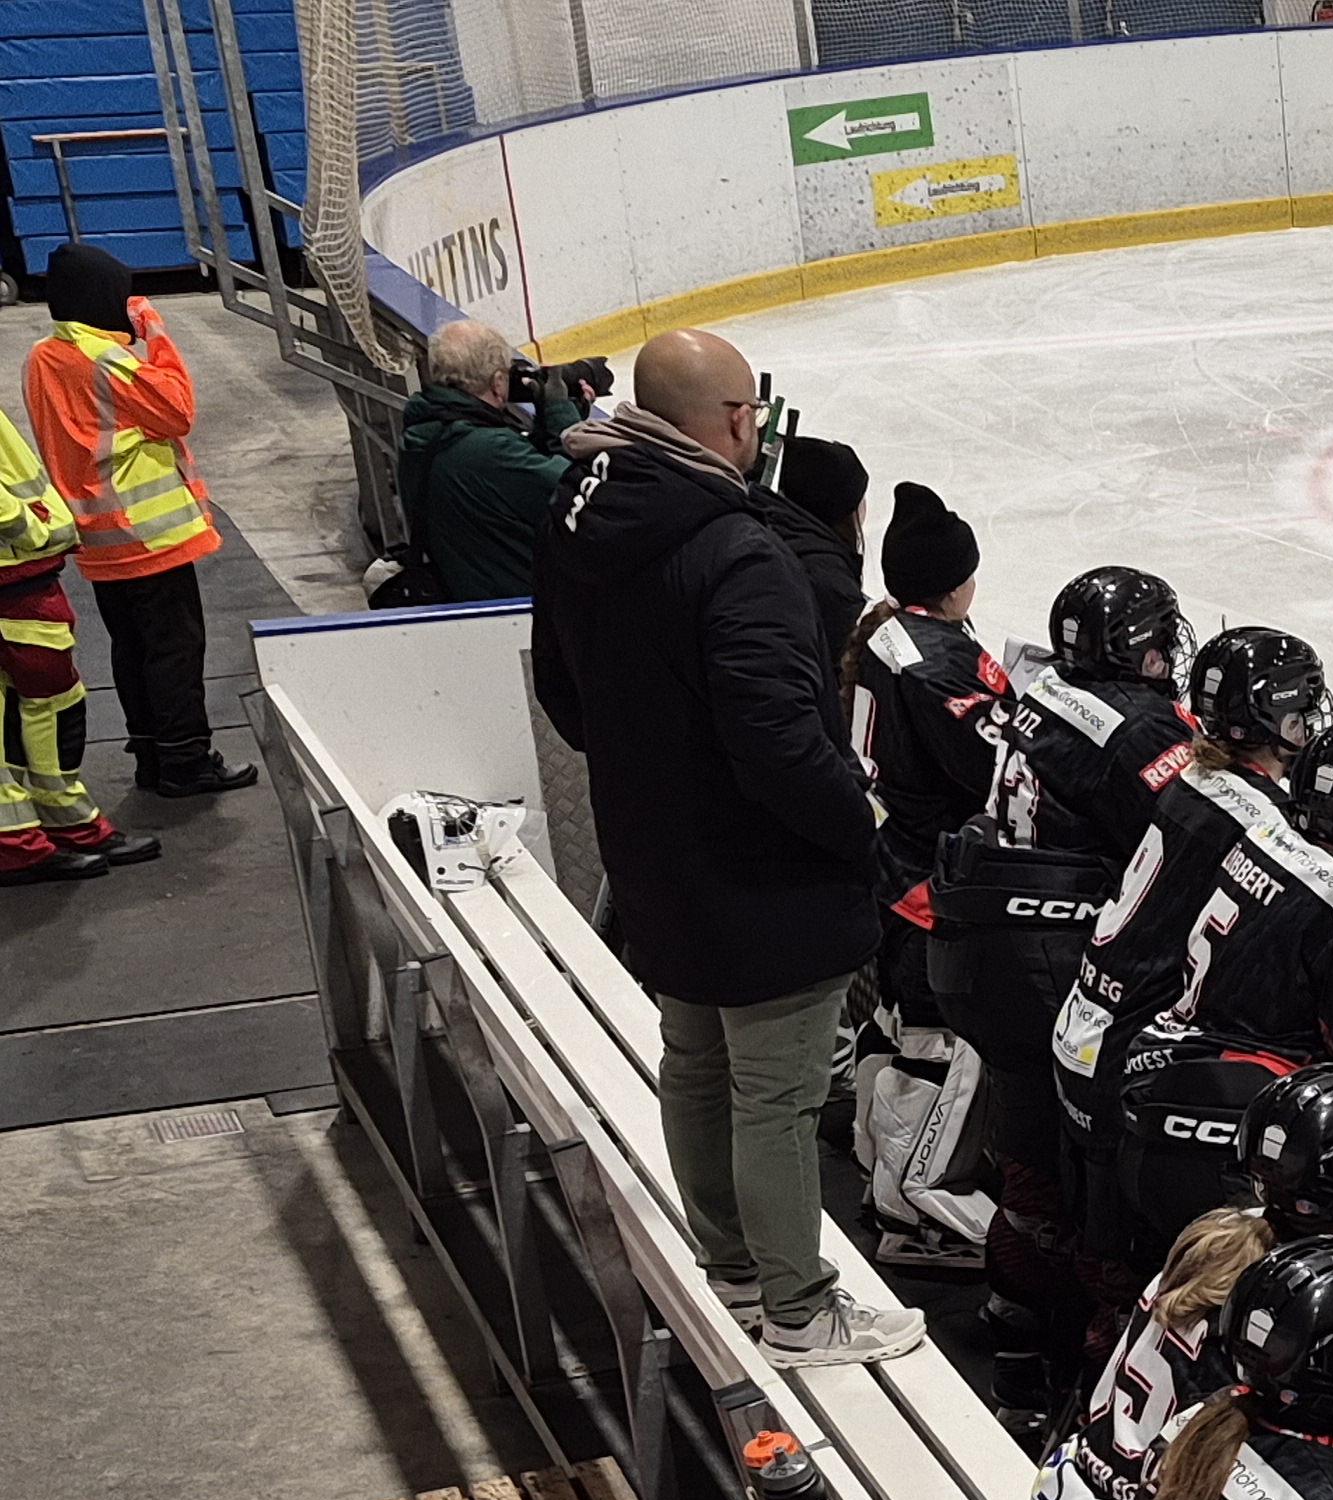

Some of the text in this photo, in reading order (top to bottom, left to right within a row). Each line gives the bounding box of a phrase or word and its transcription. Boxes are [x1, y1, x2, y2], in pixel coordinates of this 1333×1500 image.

[1187, 887, 1240, 1022] 5
[912, 1100, 952, 1185] VAPOR
[1164, 1115, 1239, 1145] CC
